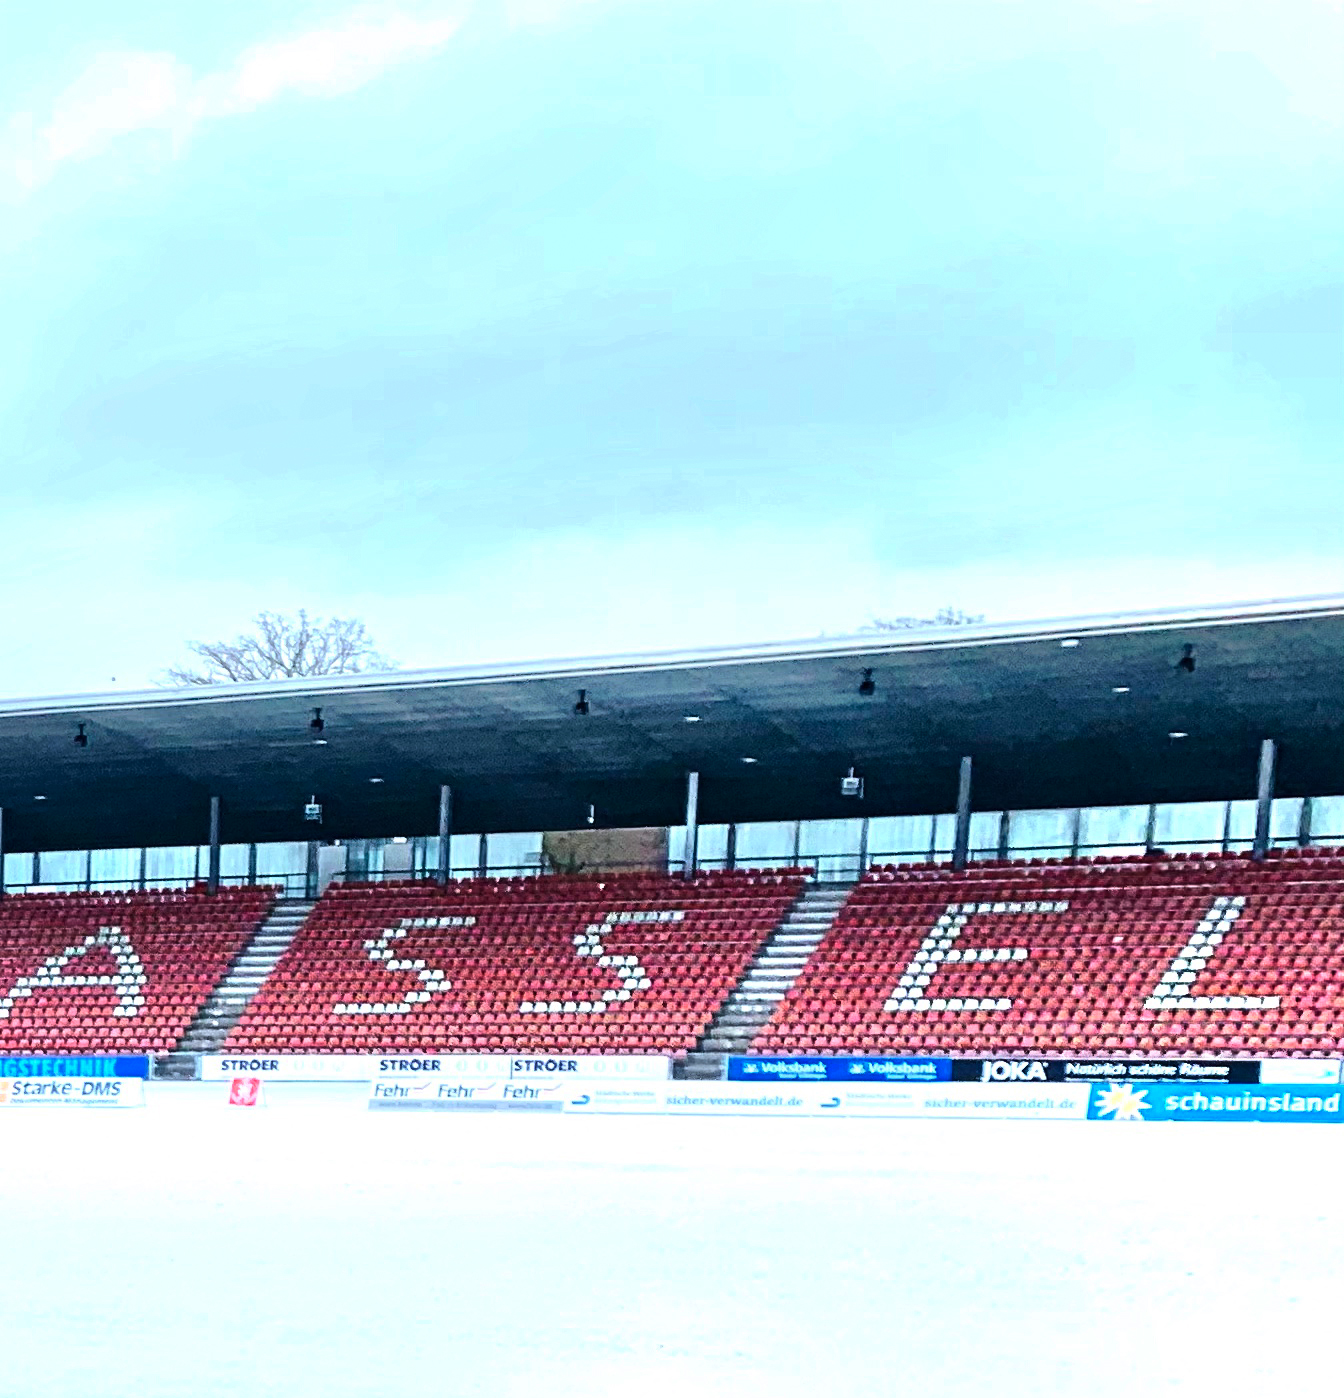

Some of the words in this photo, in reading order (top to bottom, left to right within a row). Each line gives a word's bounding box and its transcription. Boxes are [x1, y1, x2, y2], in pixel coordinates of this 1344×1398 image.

[762, 1062, 827, 1074] Volksbank
[869, 1062, 937, 1074] Volksbank
[980, 1061, 1047, 1082] JOKA
[11, 1081, 121, 1096] Starke-DMS
[375, 1084, 410, 1097] Fehr
[438, 1084, 476, 1097] Fehr
[503, 1084, 542, 1098] Fehr
[1165, 1092, 1340, 1112] schauinsland
